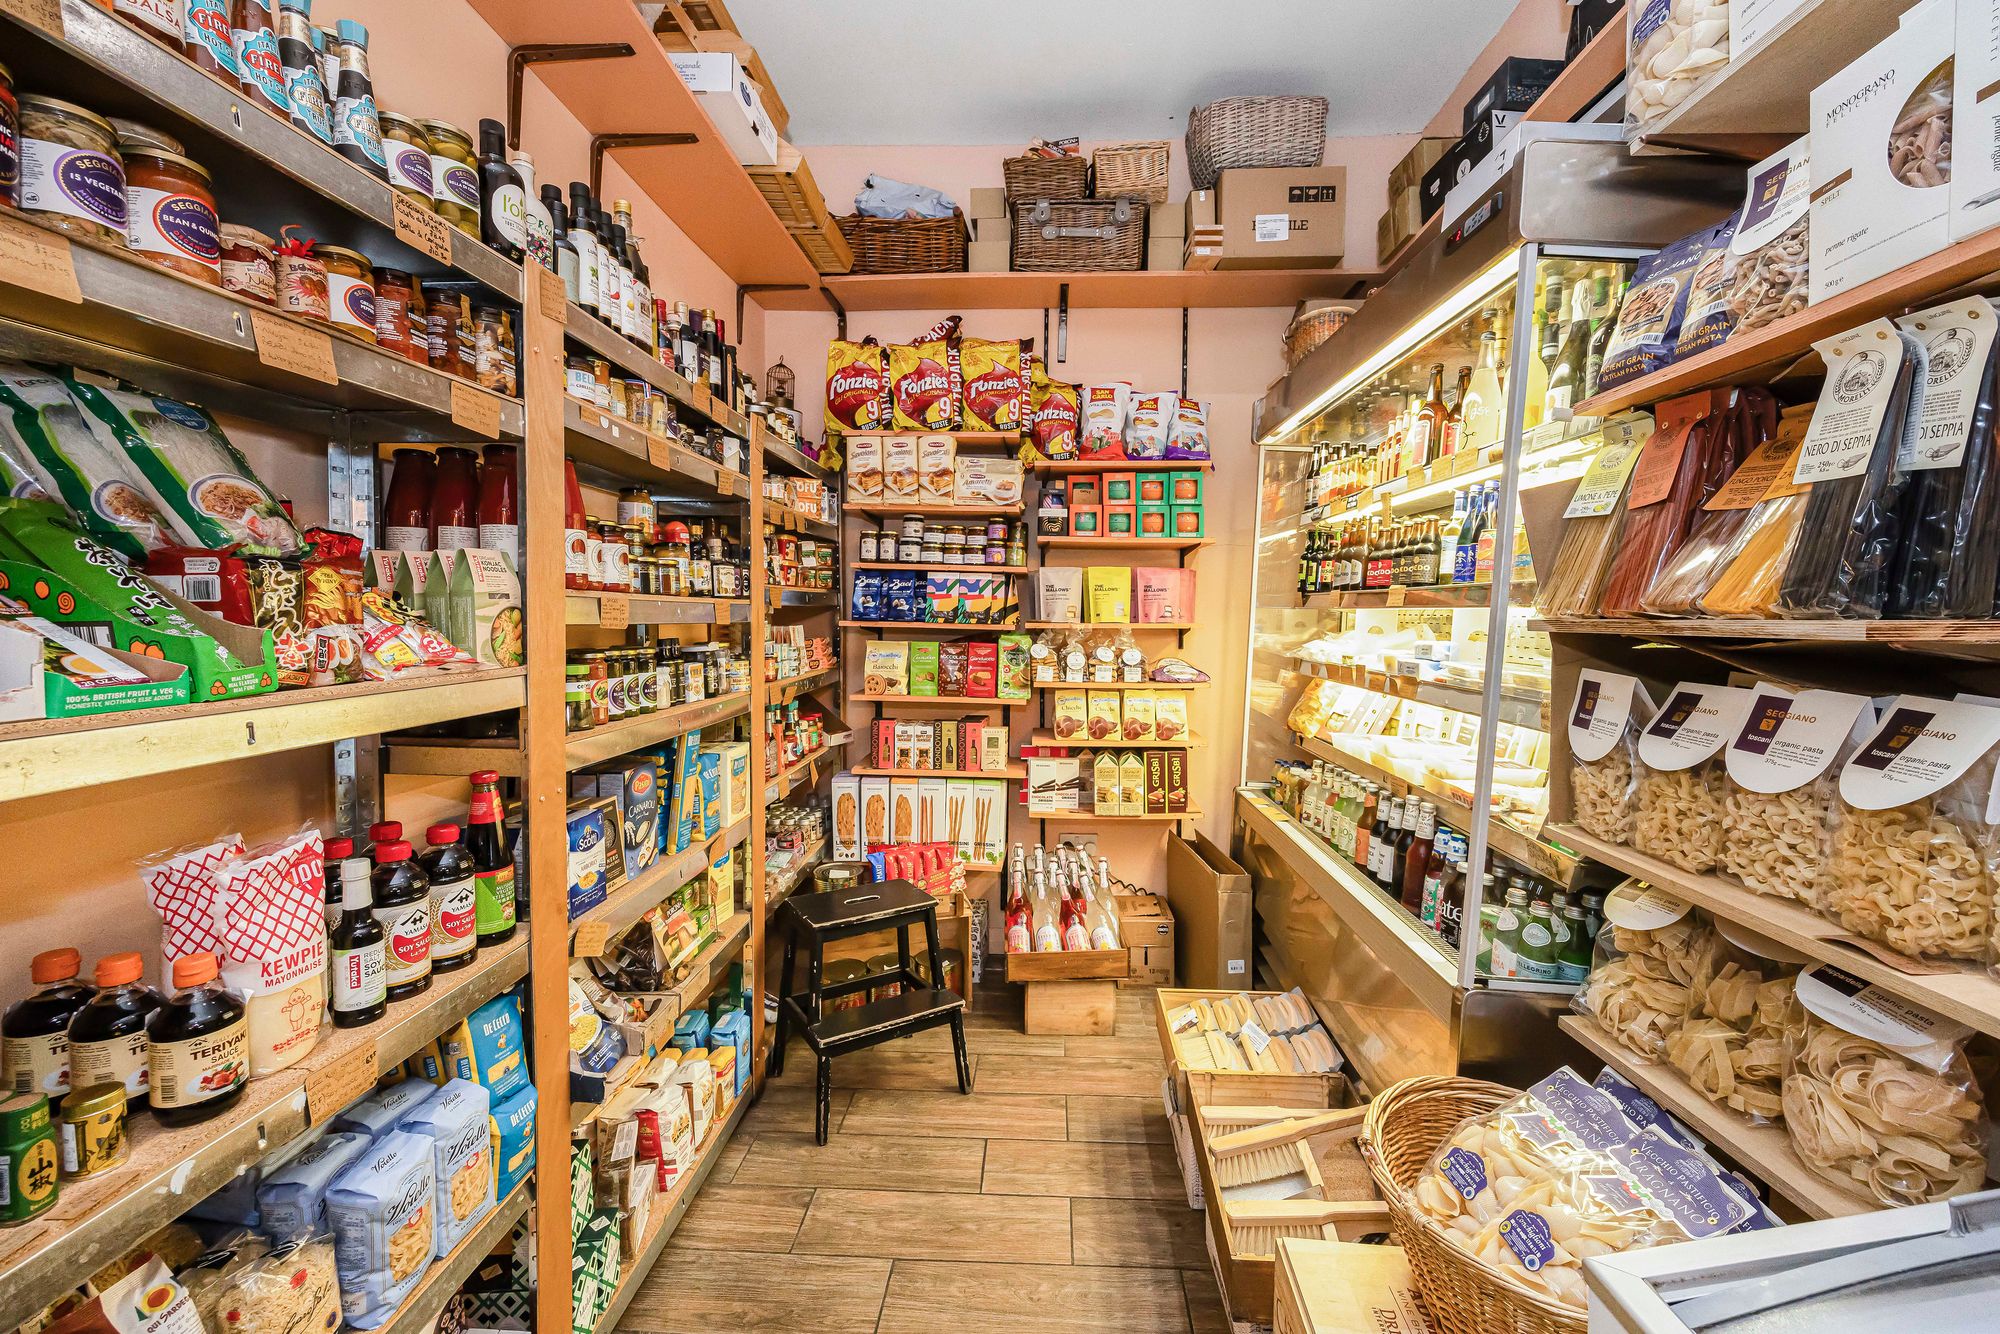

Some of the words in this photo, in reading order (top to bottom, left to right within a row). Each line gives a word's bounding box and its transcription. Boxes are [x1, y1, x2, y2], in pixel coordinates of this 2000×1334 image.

[127, 0, 182, 31] ALSA
[204, 33, 222, 47] HOT
[255, 72, 273, 88] HOT
[1825, 68, 1896, 121] MONOGRANO
[1825, 78, 1896, 129] FELICETTI
[1766, 156, 1811, 188] SEGGIAN
[1819, 189, 1842, 208] SPELT
[162, 214, 190, 227] BEAN
[191, 222, 198, 231] &
[1824, 235, 1846, 257] penne
[1845, 226, 1870, 246] rigate
[1676, 331, 1697, 347] CIENT
[1697, 320, 1733, 337] GRAIN
[1674, 340, 1697, 356] RTISAN
[1696, 332, 1724, 349] PASTA
[1626, 352, 1656, 366] GRAIN
[1626, 363, 1647, 377] PASTA
[830, 373, 879, 400] Fonzies
[901, 373, 949, 398] Fonzies
[1095, 388, 1110, 397] SAN
[1091, 393, 1114, 401] CARLO
[865, 399, 880, 421] 9
[938, 397, 951, 419] 9
[1007, 398, 1020, 421] 9
[1930, 422, 1965, 439] SEPPIA
[1062, 429, 1073, 452] 9
[1803, 441, 1830, 458] NERO
[1830, 440, 1841, 453] DI
[1841, 433, 1872, 451] SEPPIA
[797, 481, 818, 494] OFU
[1750, 474, 1777, 484] PORCIN
[1603, 488, 1620, 501] PEPE
[798, 500, 817, 514] OFU
[382, 556, 394, 582] Yutaka
[414, 557, 426, 583] Yutaka
[481, 560, 502, 568] KONJAC
[483, 564, 508, 573] NOODLES
[855, 575, 880, 587] Baci
[889, 579, 913, 589] Baci
[65, 695, 91, 704] 100%
[92, 691, 126, 702] BRITISH
[127, 688, 151, 698] FRUIT
[151, 688, 158, 696] &
[160, 687, 174, 695] VEG
[104, 698, 138, 707] NOTHING
[153, 694, 174, 702] ADDED
[1764, 707, 1818, 725] SEGGIANO
[1681, 726, 1705, 737] organic
[1703, 730, 1720, 740] pasta
[1747, 733, 1773, 744] toscani
[1900, 724, 1958, 742] SEGGIANO
[871, 720, 880, 769] MONDOVINO
[934, 721, 943, 770] MONDOVINO
[958, 722, 967, 771] MONDOVINO
[1774, 738, 1802, 751] organic
[1801, 743, 1825, 756] pasta
[1870, 747, 1898, 760] toscani
[1898, 753, 1932, 766] organic
[1930, 759, 1952, 771] pasta
[1439, 899, 1463, 922] ate
[445, 920, 461, 930] SOY
[260, 939, 324, 978] KEWPIE
[398, 944, 415, 955] SOY
[363, 954, 381, 964] SALT
[363, 960, 382, 971] SOY
[264, 957, 323, 988] MAYONNAISE
[350, 955, 361, 989] Yutaka
[1821, 965, 1866, 991] pappardelle
[1848, 1000, 1868, 1015] 375g
[1867, 986, 1906, 1013] organic
[1904, 1006, 1936, 1028] pasta
[210, 1047, 240, 1064] SAUCE
[1554, 1079, 1588, 1110] VECCHIO
[1628, 1152, 1706, 1225] GRAGNANO
[1639, 1140, 1679, 1177] VECCHIO
[1676, 1173, 1721, 1221] PASTIFICIO
[1396, 1289, 1415, 1317] WINE
